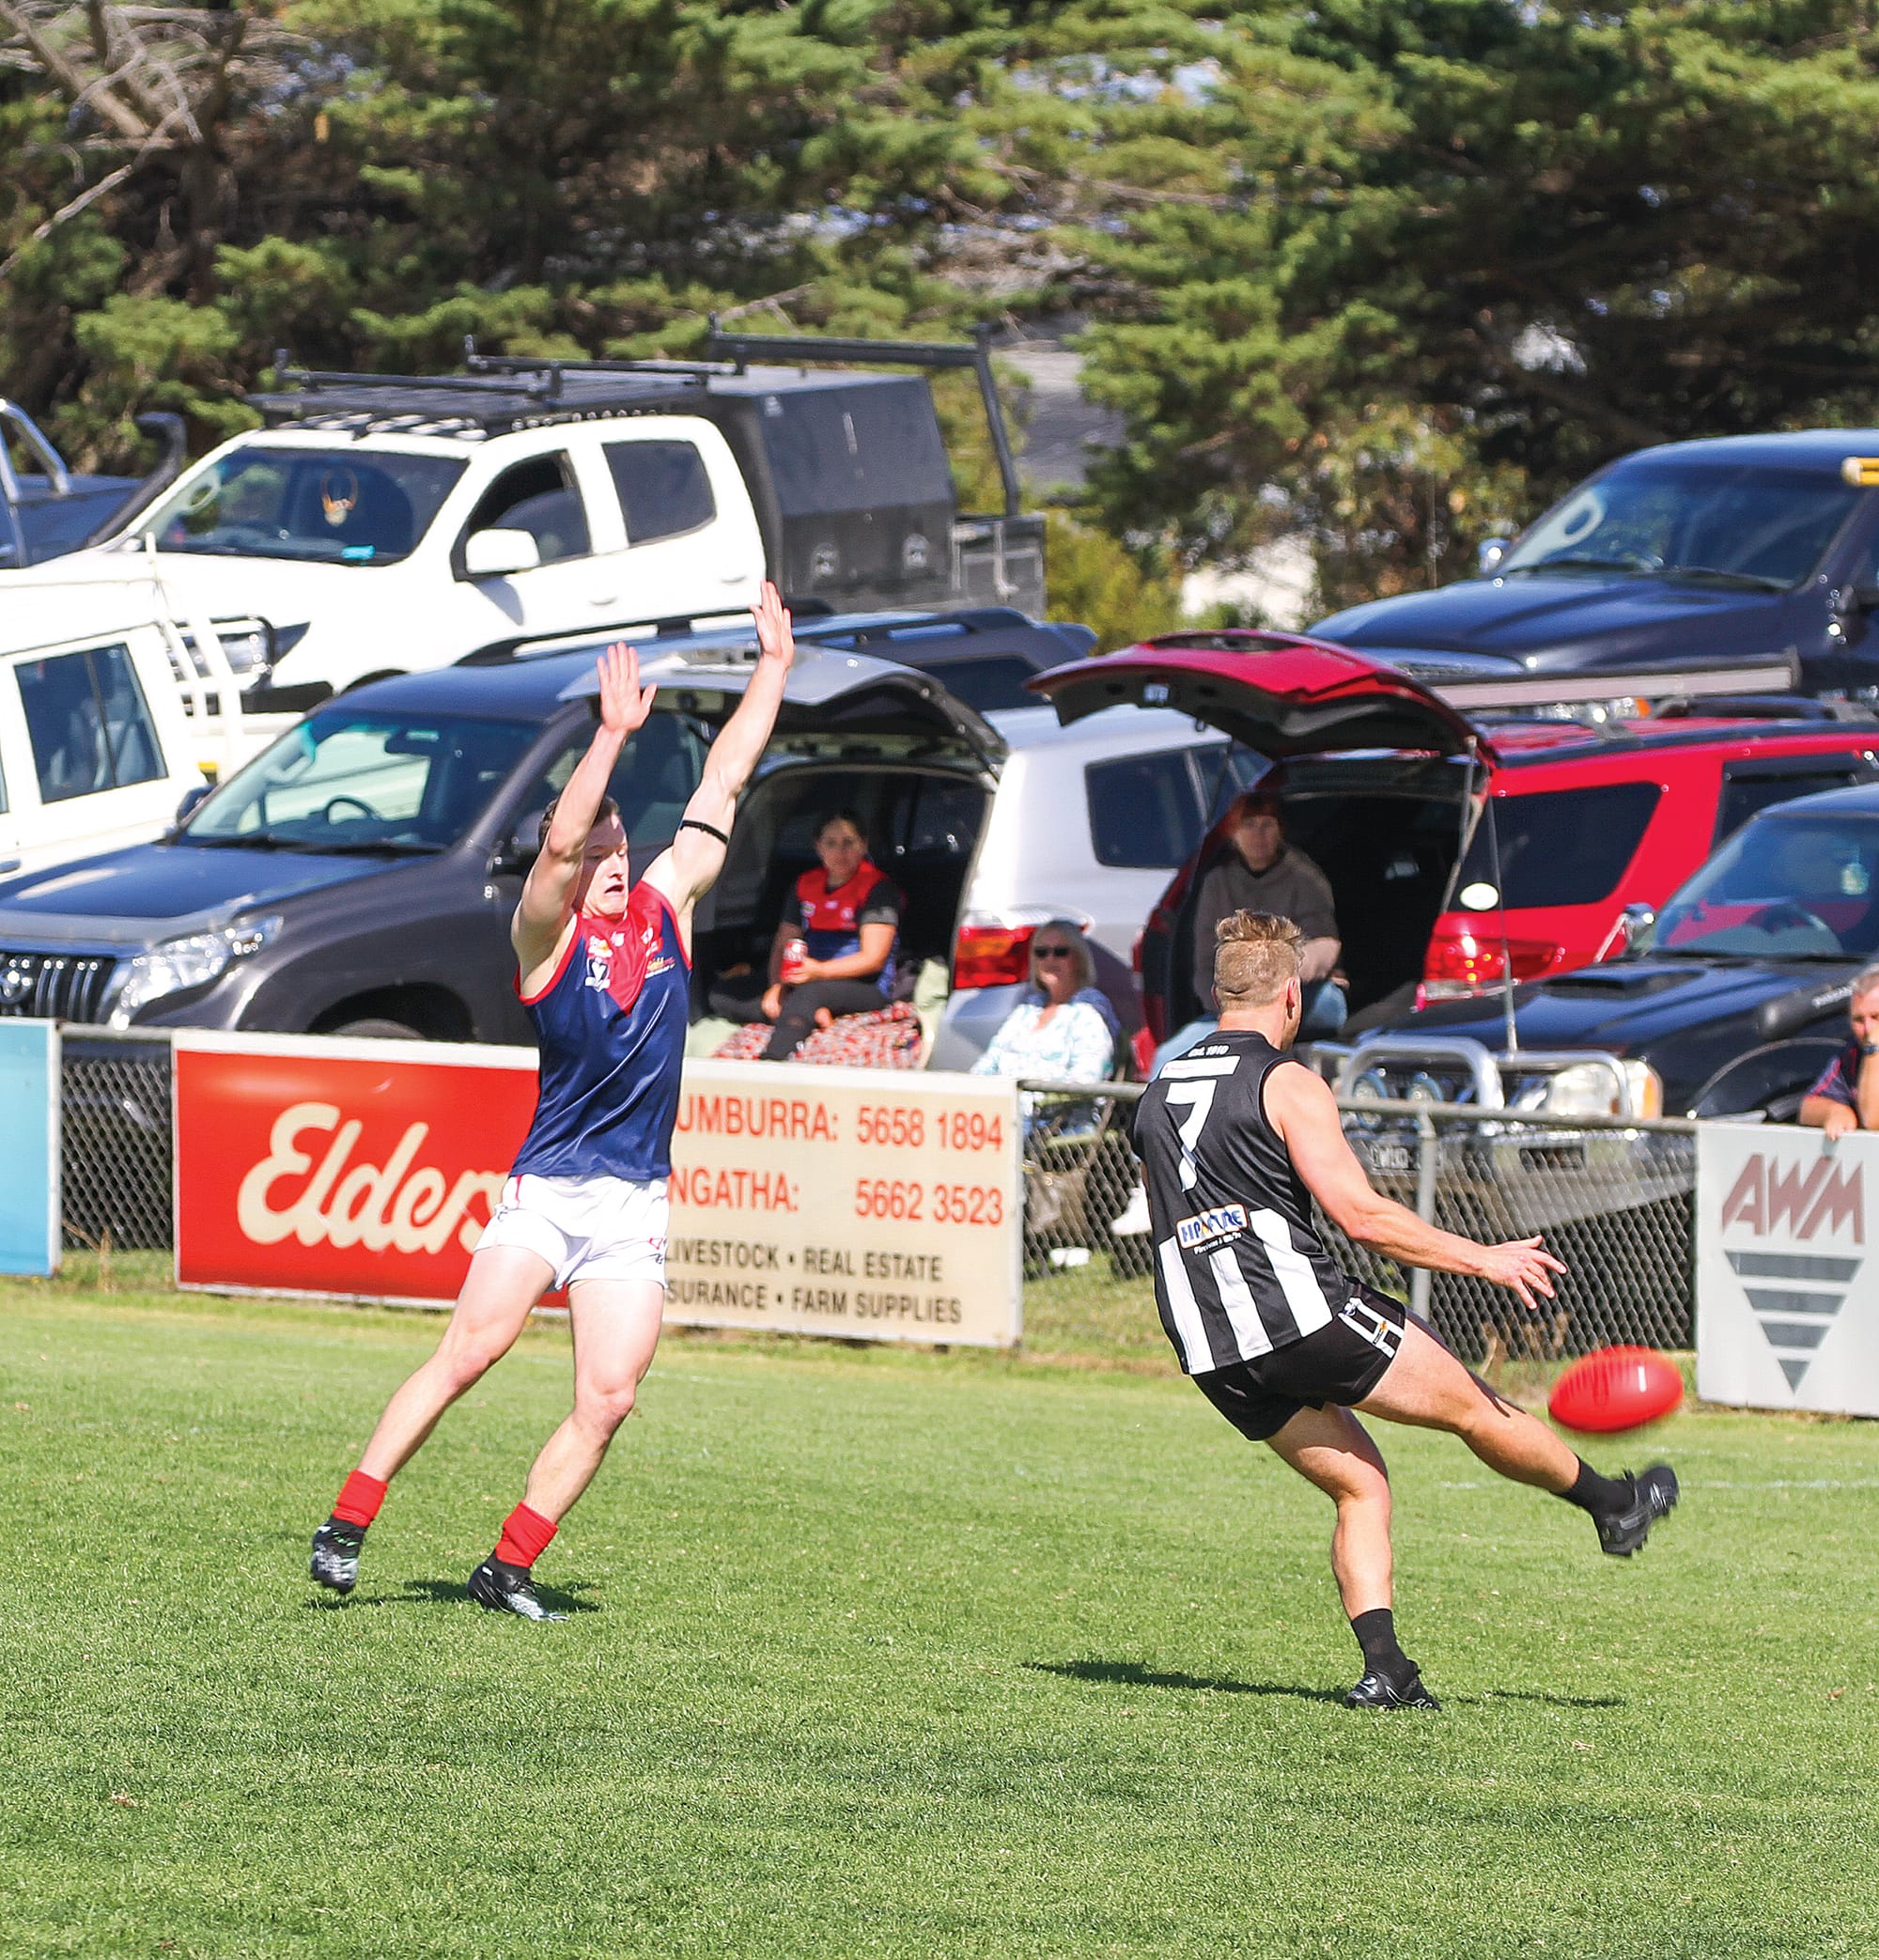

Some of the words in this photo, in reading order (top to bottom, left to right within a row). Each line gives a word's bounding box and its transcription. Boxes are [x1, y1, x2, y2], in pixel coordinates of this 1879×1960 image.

[857, 1106, 925, 1147] 5658
[938, 1111, 1003, 1152] 1894
[1164, 1080, 1218, 1192] 7
[856, 1180, 924, 1221] 5662
[934, 1184, 1003, 1225] 3523
[1721, 1153, 1866, 1245] AWM
[665, 1237, 780, 1269] IVESTOCK
[803, 1246, 857, 1277] REAL
[864, 1251, 942, 1282] ESTATE
[792, 1287, 847, 1314] FARM
[856, 1293, 962, 1324] SUPPLIES
